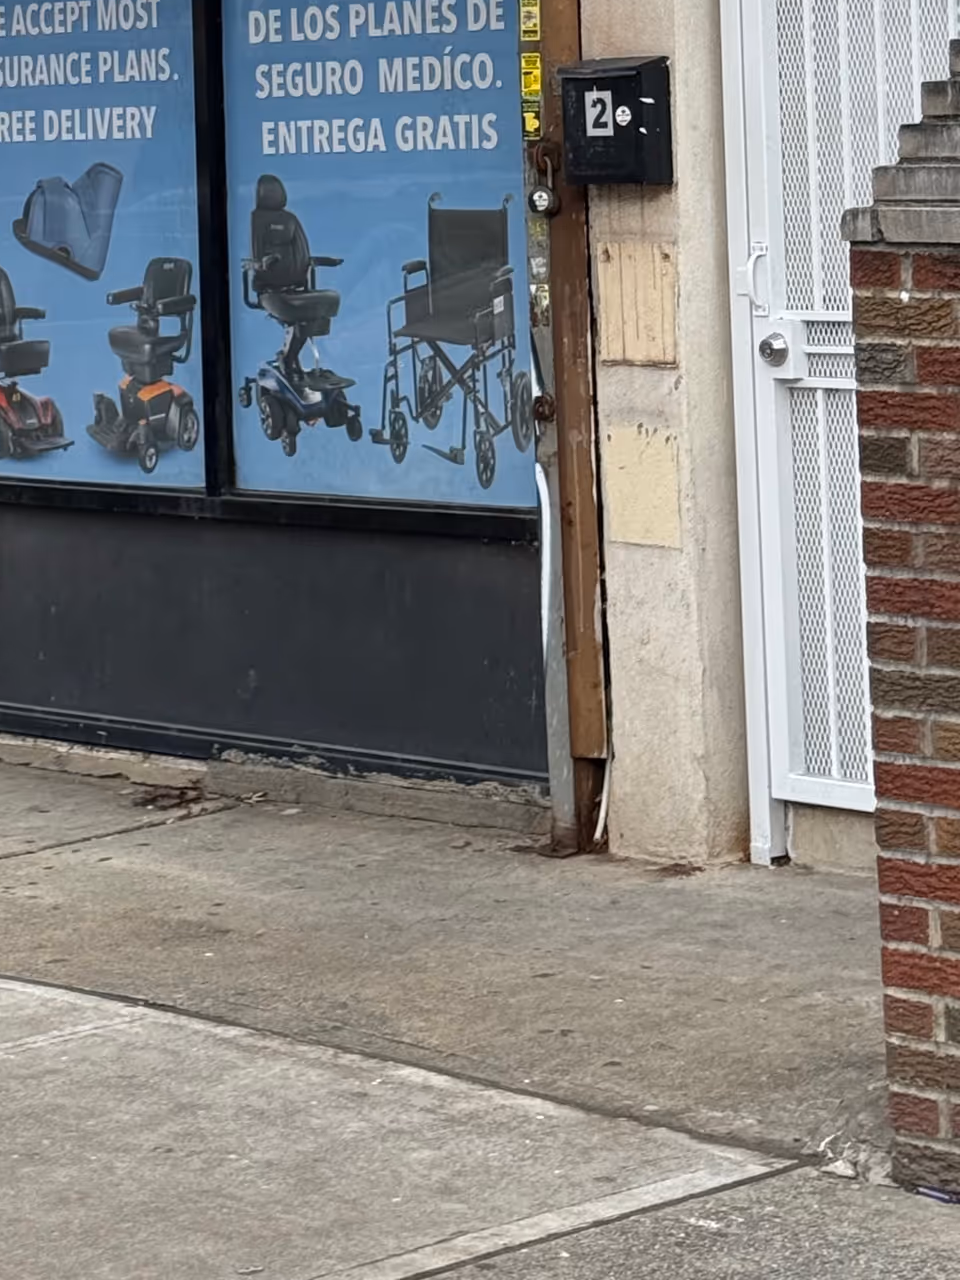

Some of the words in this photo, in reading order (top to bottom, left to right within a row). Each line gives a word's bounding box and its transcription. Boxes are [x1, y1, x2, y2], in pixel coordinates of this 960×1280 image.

[10, 0, 92, 36] ACCEPT
[248, 9, 282, 45] DE
[291, 4, 340, 42] LOS
[98, 47, 179, 85] PLANS.
[255, 60, 363, 100] SEGURO
[378, 46, 502, 94] MEDÍCO.
[43, 106, 157, 141] DELIVERY
[591, 97, 609, 129] 2
[262, 118, 386, 156] ENTREGA
[395, 112, 498, 152] GRATIS
